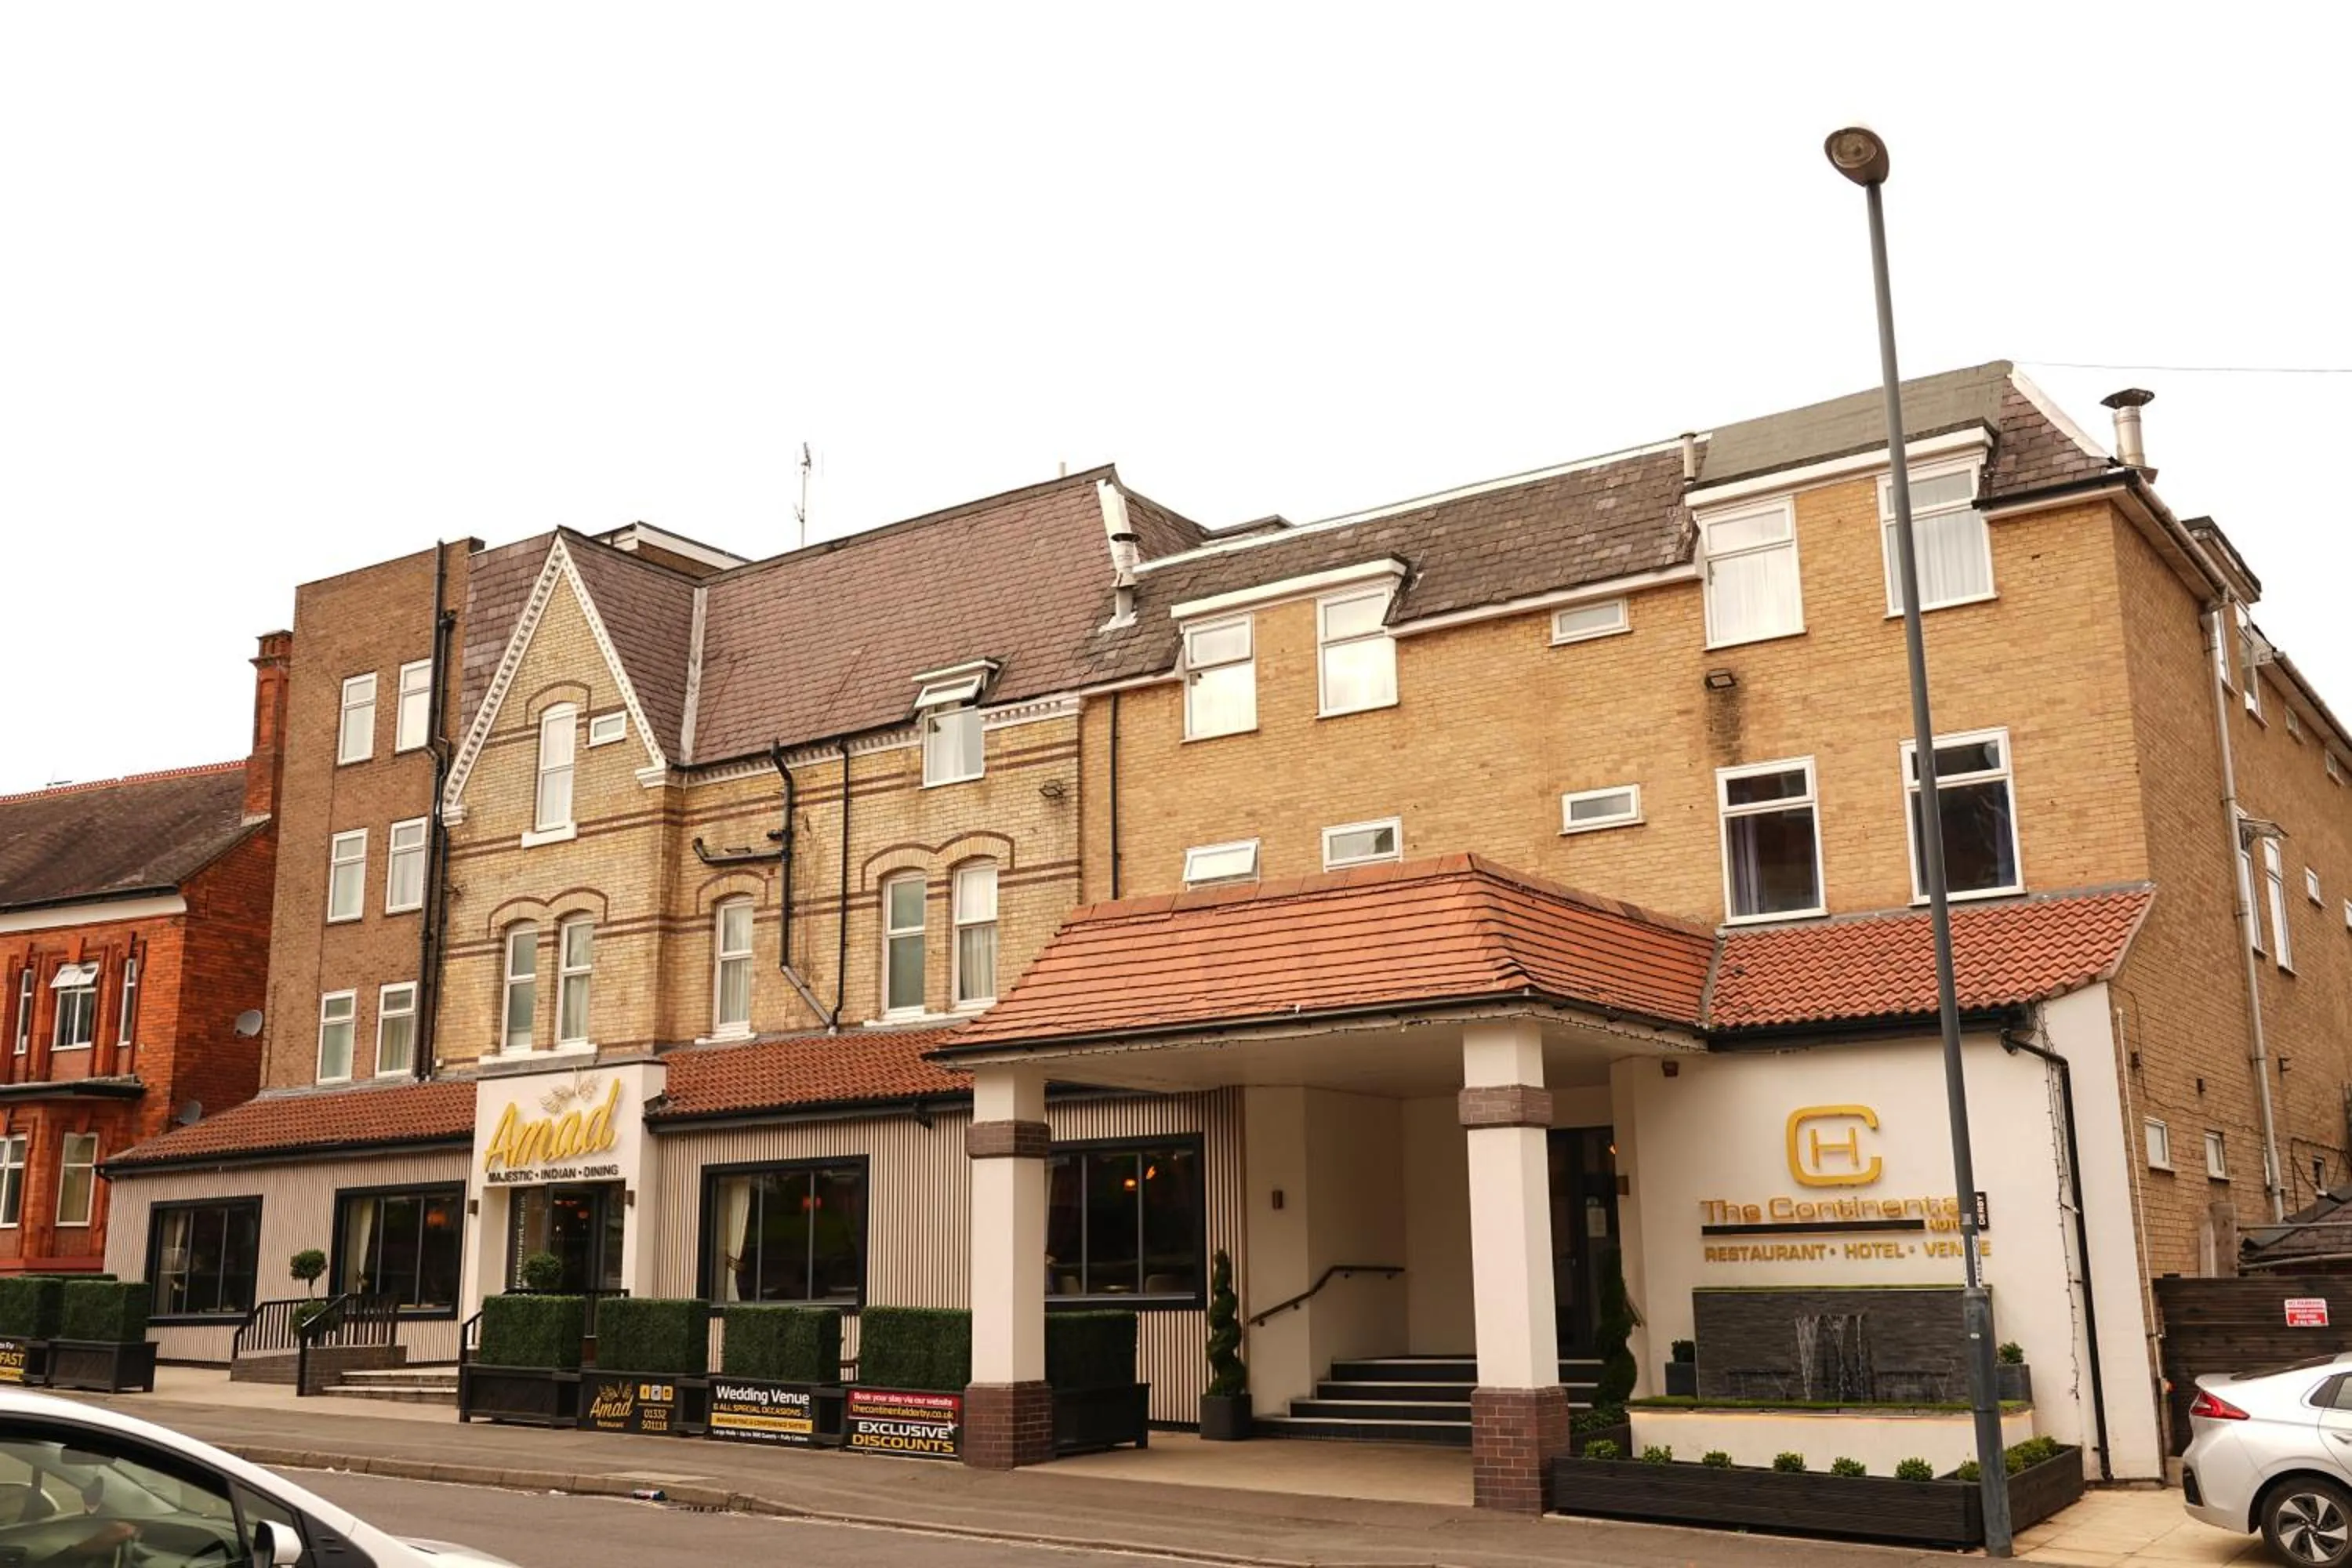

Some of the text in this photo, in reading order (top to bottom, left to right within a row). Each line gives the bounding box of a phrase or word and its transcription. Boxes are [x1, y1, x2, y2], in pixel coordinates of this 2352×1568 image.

[484, 1078, 621, 1173] Amad
[488, 1164, 619, 1183] MAJESTIC INDIAN DINING
[1700, 1195, 1960, 1223] The Continenta
[1976, 1195, 1986, 1225] DERBY
[1704, 1240, 1992, 1262] RESTAURANT HOTEL VENE
[717, 1385, 810, 1405] Wedding Venue
[590, 1395, 633, 1418] Amad
[858, 1421, 949, 1439] EXCLUSIVE
[852, 1434, 954, 1453] DISCOUNTS
